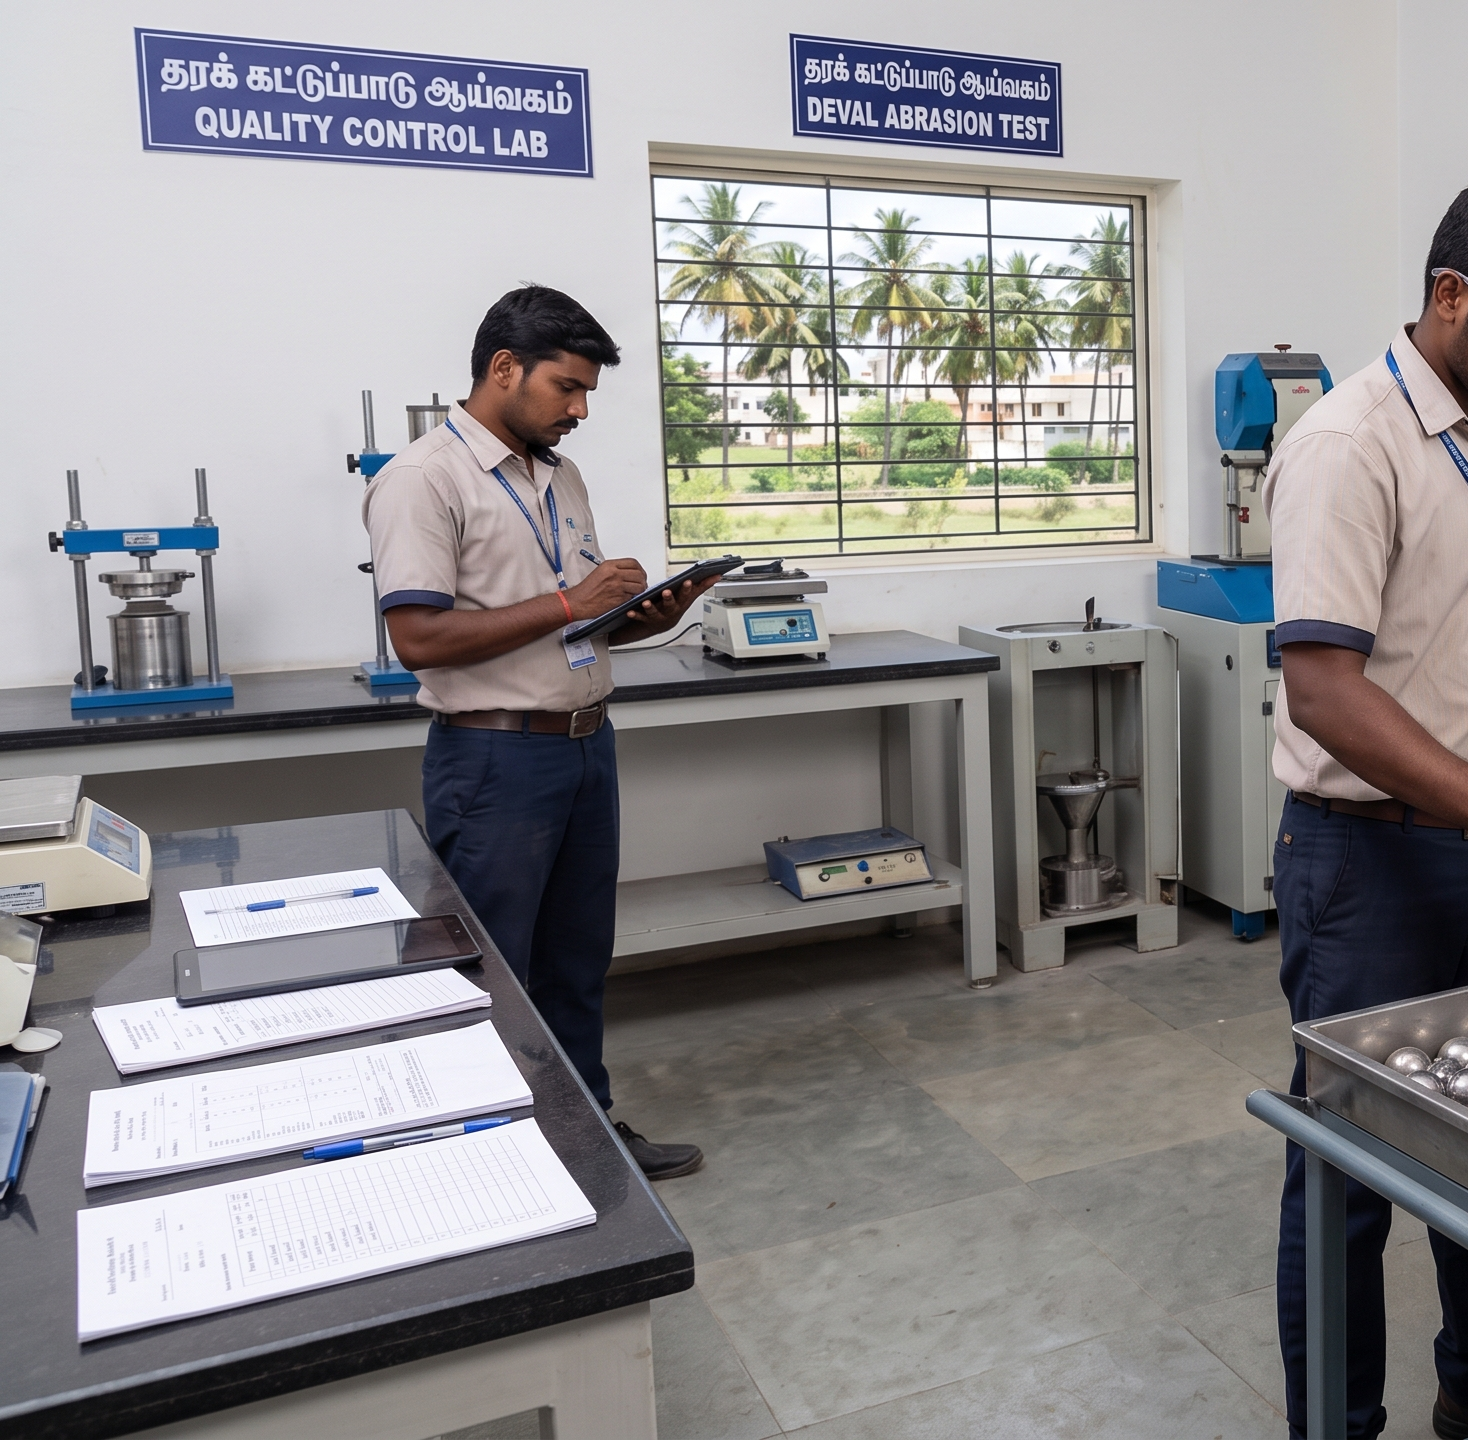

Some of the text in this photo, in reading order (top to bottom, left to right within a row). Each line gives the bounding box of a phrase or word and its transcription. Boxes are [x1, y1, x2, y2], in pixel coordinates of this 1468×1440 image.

[161, 52, 573, 115] தரக் கட்டுப்பாடு ஆய்வகம்
[804, 53, 1051, 100] தரக் கட்டுப்பாடு ஆய்வகம்
[195, 106, 548, 159] QUALITY CONTROL LAB
[807, 96, 1050, 141] DEVAL ABRASION TEST
